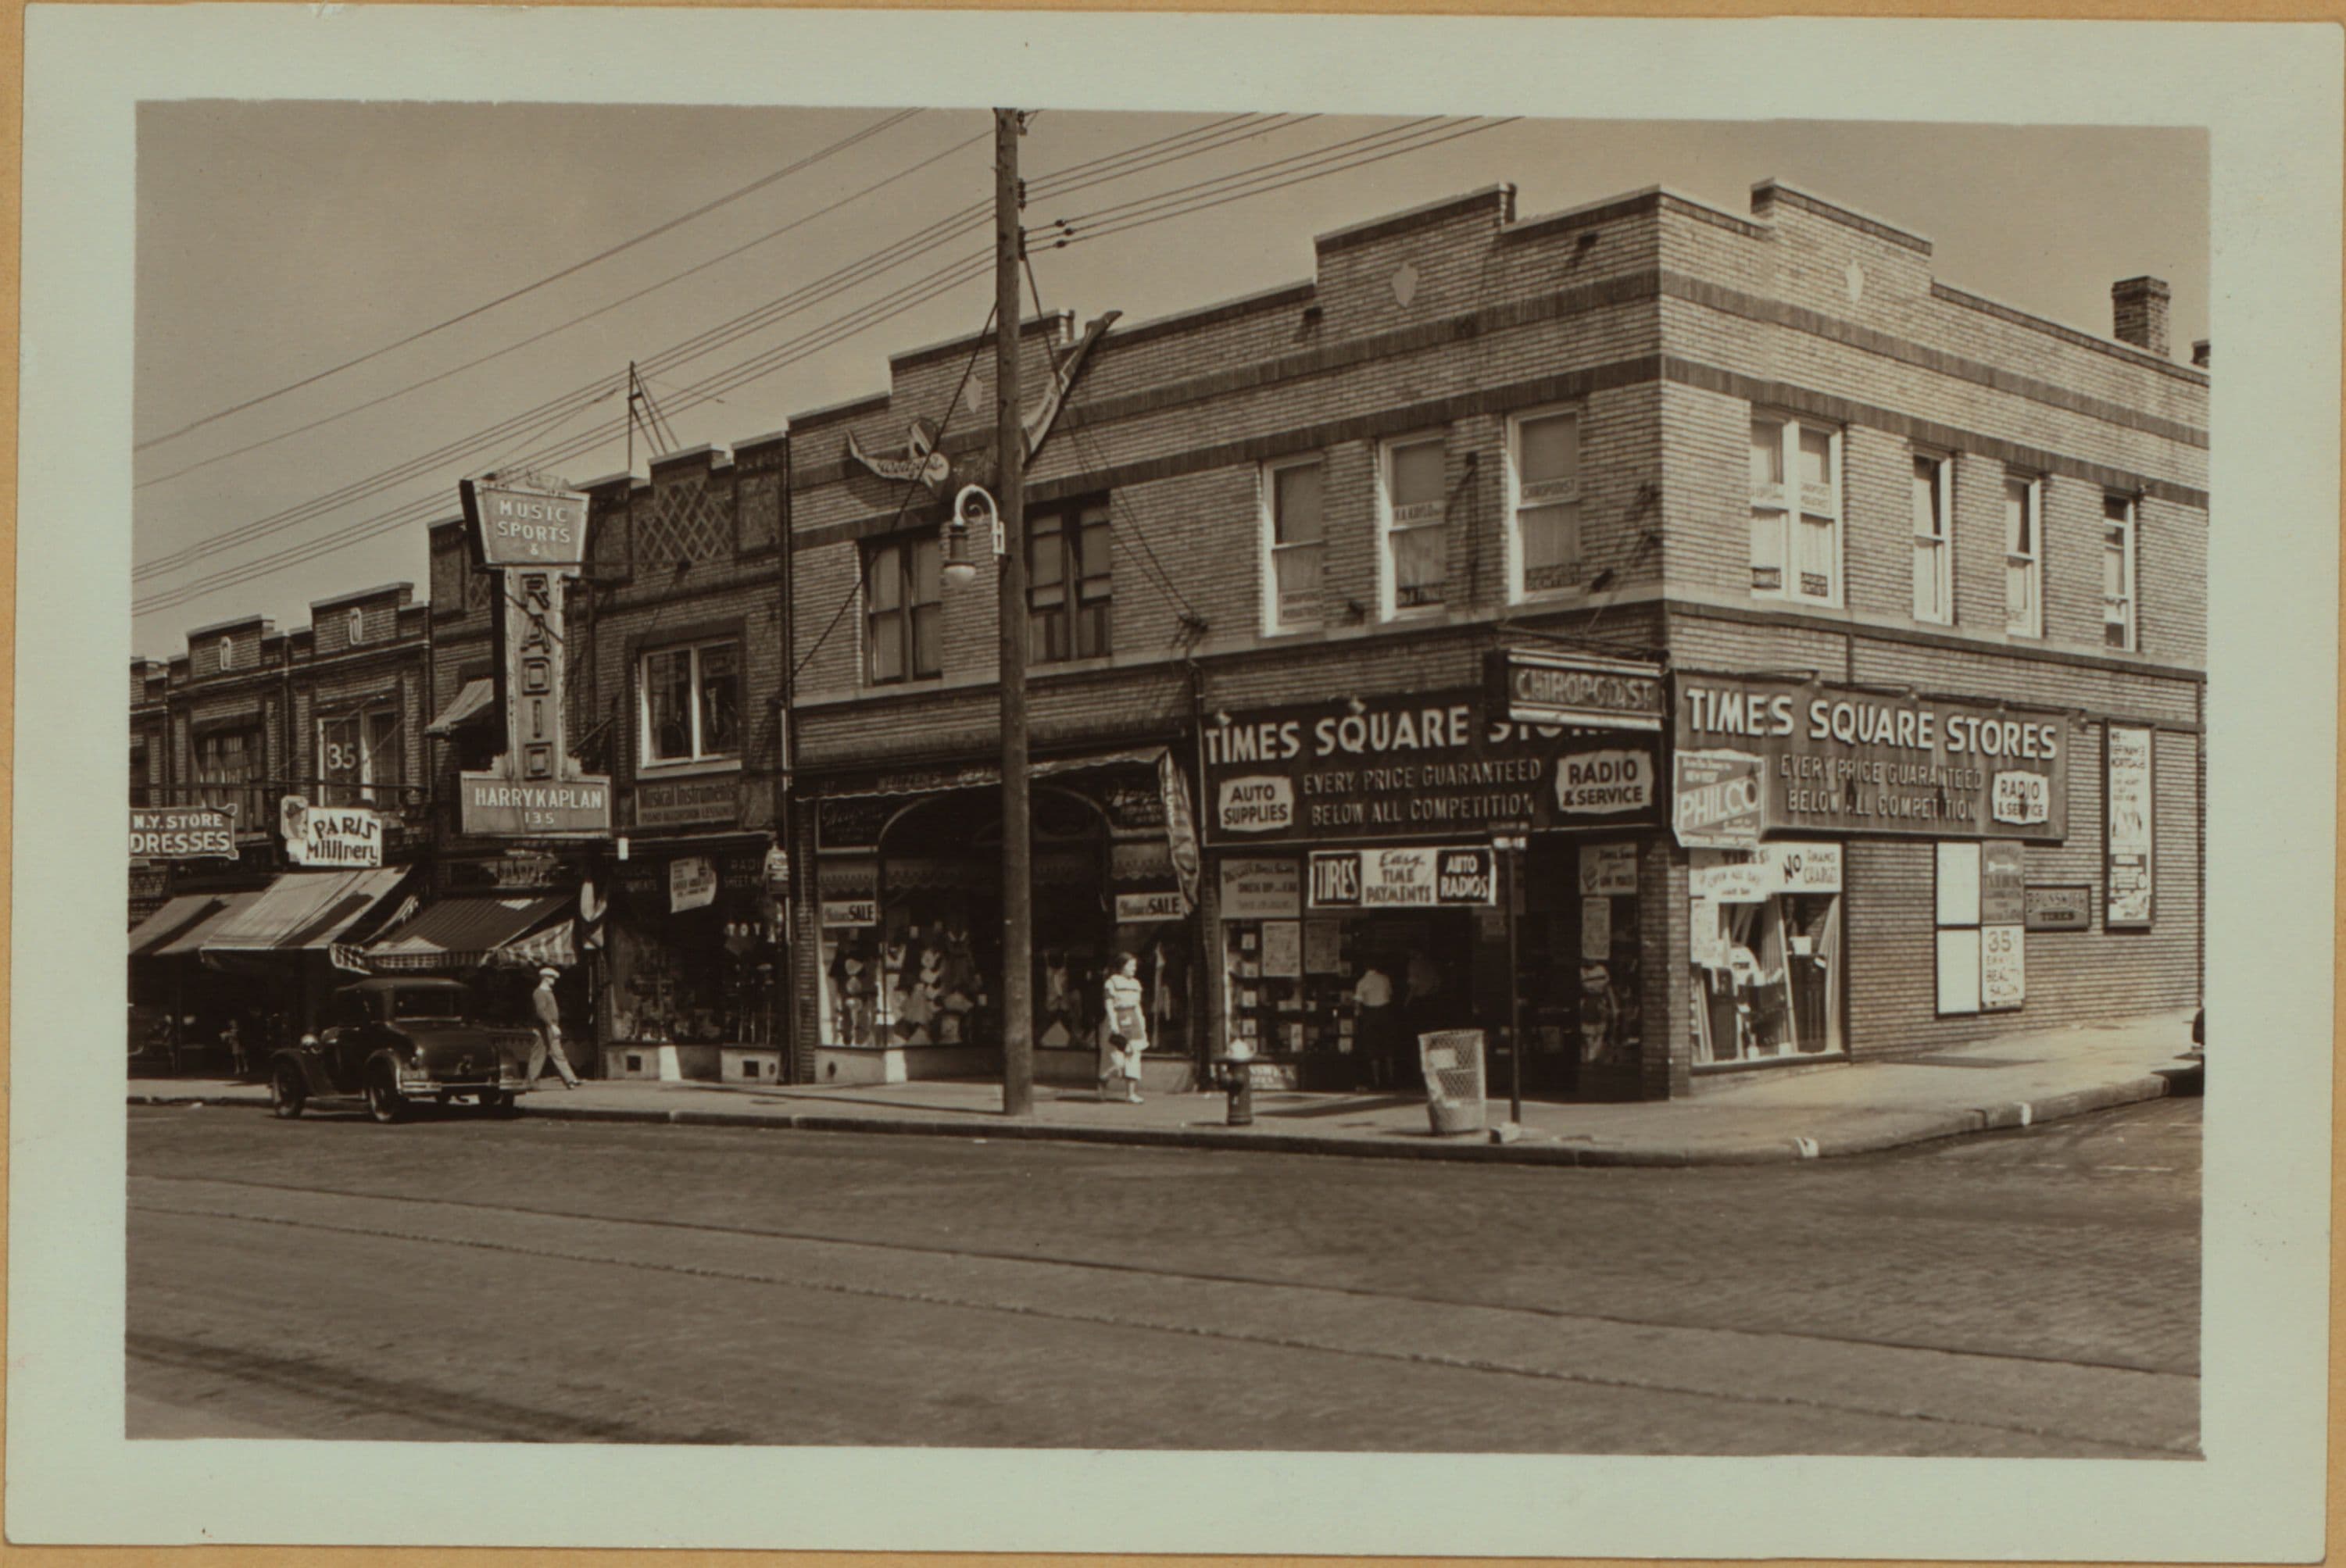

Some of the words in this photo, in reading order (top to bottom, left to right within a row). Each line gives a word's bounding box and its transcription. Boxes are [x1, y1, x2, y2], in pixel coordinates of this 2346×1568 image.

[499, 499, 568, 523] MUSIC
[497, 521, 570, 543] SPORTS
[529, 543, 539, 556] &
[520, 573, 553, 780] RADIO
[1686, 688, 1793, 736] TIMES
[1809, 701, 1934, 749] SQUARE
[1946, 716, 2058, 759] STORES
[1206, 722, 1300, 765] TIMES
[1315, 705, 1470, 755] SQUARE
[1304, 770, 1357, 795] EVERY
[1364, 766, 1414, 791] PRICE
[1422, 759, 1542, 787] GUARANTEED
[1568, 761, 1638, 785] RADIO
[1781, 754, 1832, 779] EVERY
[1837, 760, 1881, 784] PRICE
[1887, 763, 1983, 791] GUARANTEED
[475, 786, 535, 808] HARRY
[535, 789, 603, 809] KAPLAN
[1230, 785, 1275, 802] AUTO
[1576, 786, 1644, 805] SERVICE
[2000, 780, 2040, 801] RADIO
[1224, 804, 1289, 825] SUPPLIES
[1312, 802, 1364, 825] BELOW
[1371, 801, 1403, 823] ALL
[1410, 793, 1535, 820] COMPETITION
[1680, 780, 1758, 829] PHILCO
[1788, 788, 1837, 813] BELOW
[1845, 792, 1871, 816] ALL
[1878, 795, 1976, 820] COMPETITION
[167, 813, 224, 829] STORE
[313, 816, 378, 840] PARIS
[524, 812, 555, 825] 135
[130, 830, 231, 853] DRESSES
[1379, 852, 1426, 867] Easy
[1447, 855, 1478, 873] AUTO
[1783, 853, 1802, 884] NO
[1315, 859, 1357, 900] TIRES
[1382, 868, 1414, 883] TIME
[1366, 886, 1431, 902] PAYMENTS
[1441, 877, 1488, 898] RADIOS
[849, 905, 873, 920] SALE
[1148, 896, 1180, 915] SALE
[2040, 911, 2075, 921] TIRES
